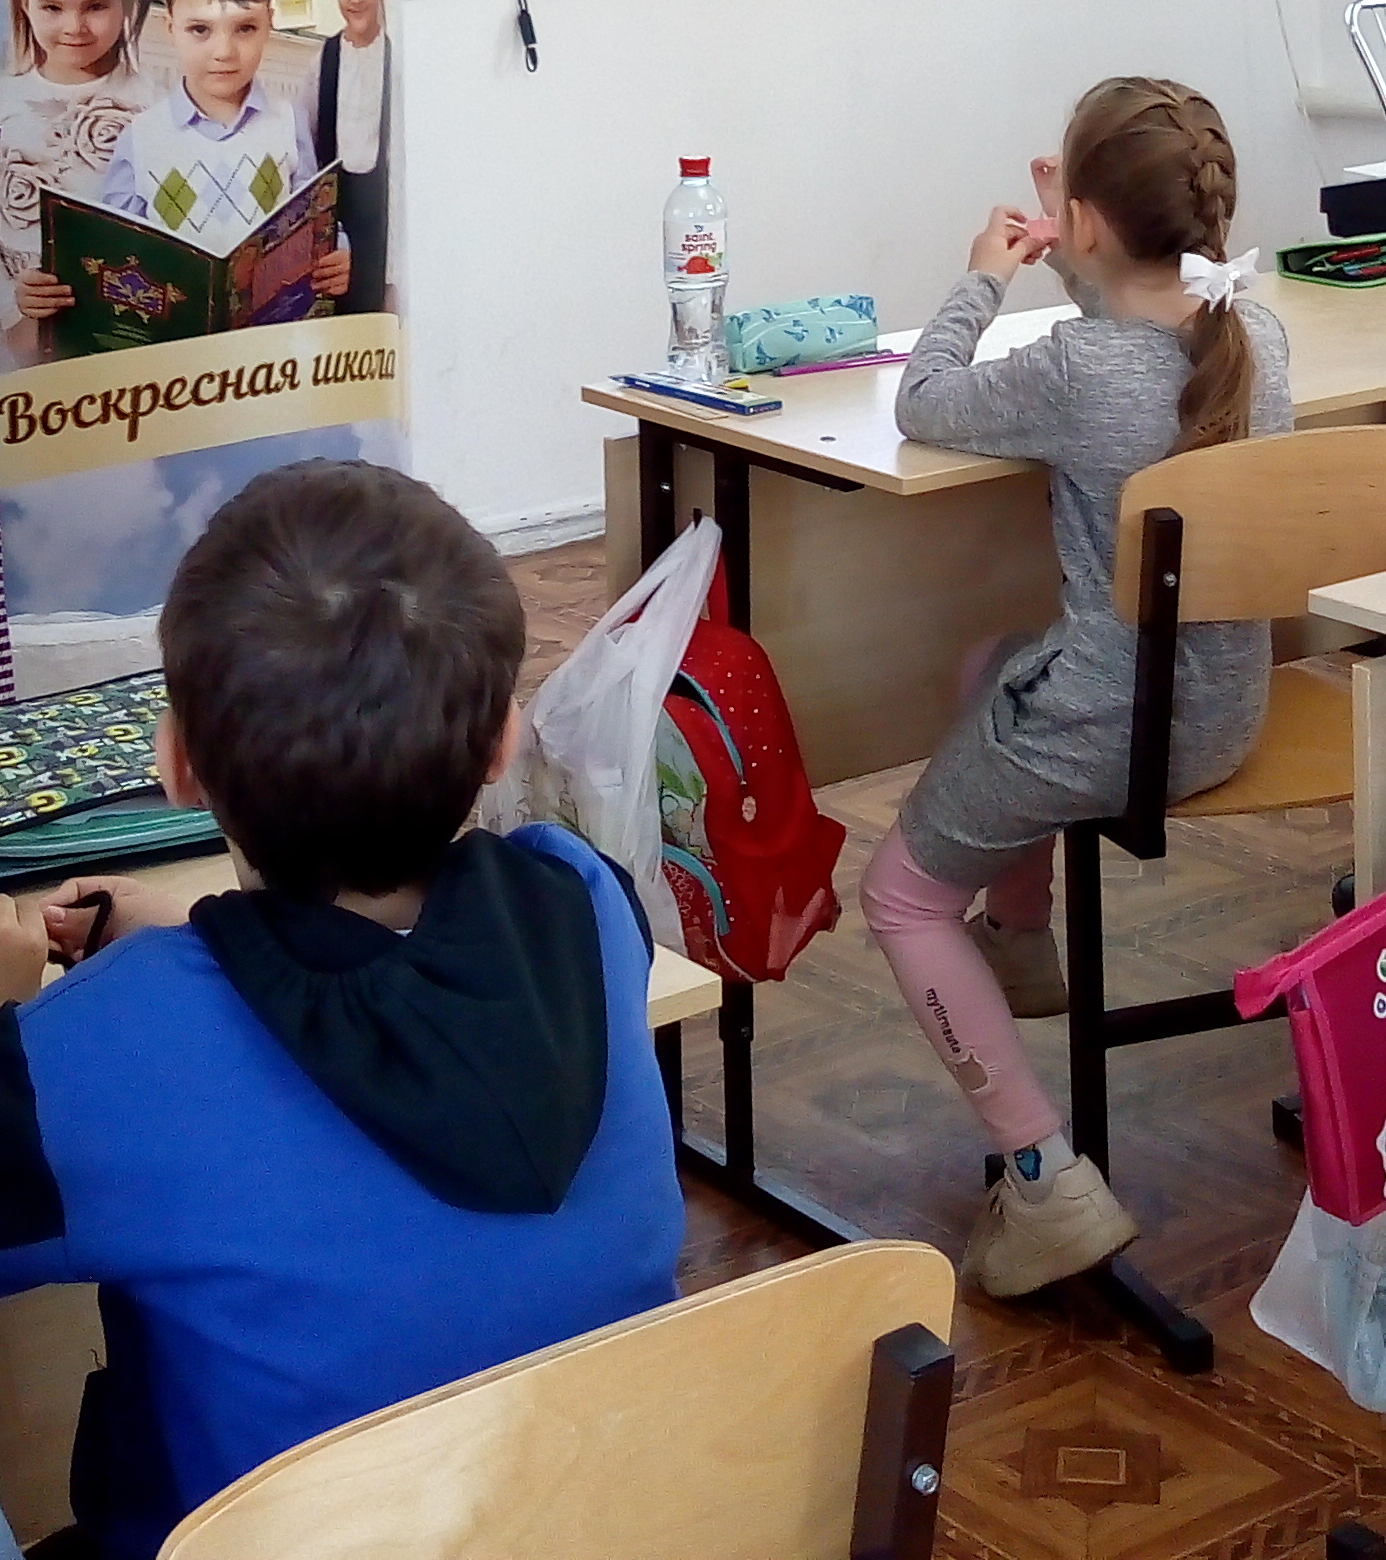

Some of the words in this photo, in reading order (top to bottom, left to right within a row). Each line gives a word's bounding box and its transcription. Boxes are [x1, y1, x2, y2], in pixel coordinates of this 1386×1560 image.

[684, 232, 715, 242] saint
[681, 242, 717, 254] spring
[311, 346, 397, 388] школа
